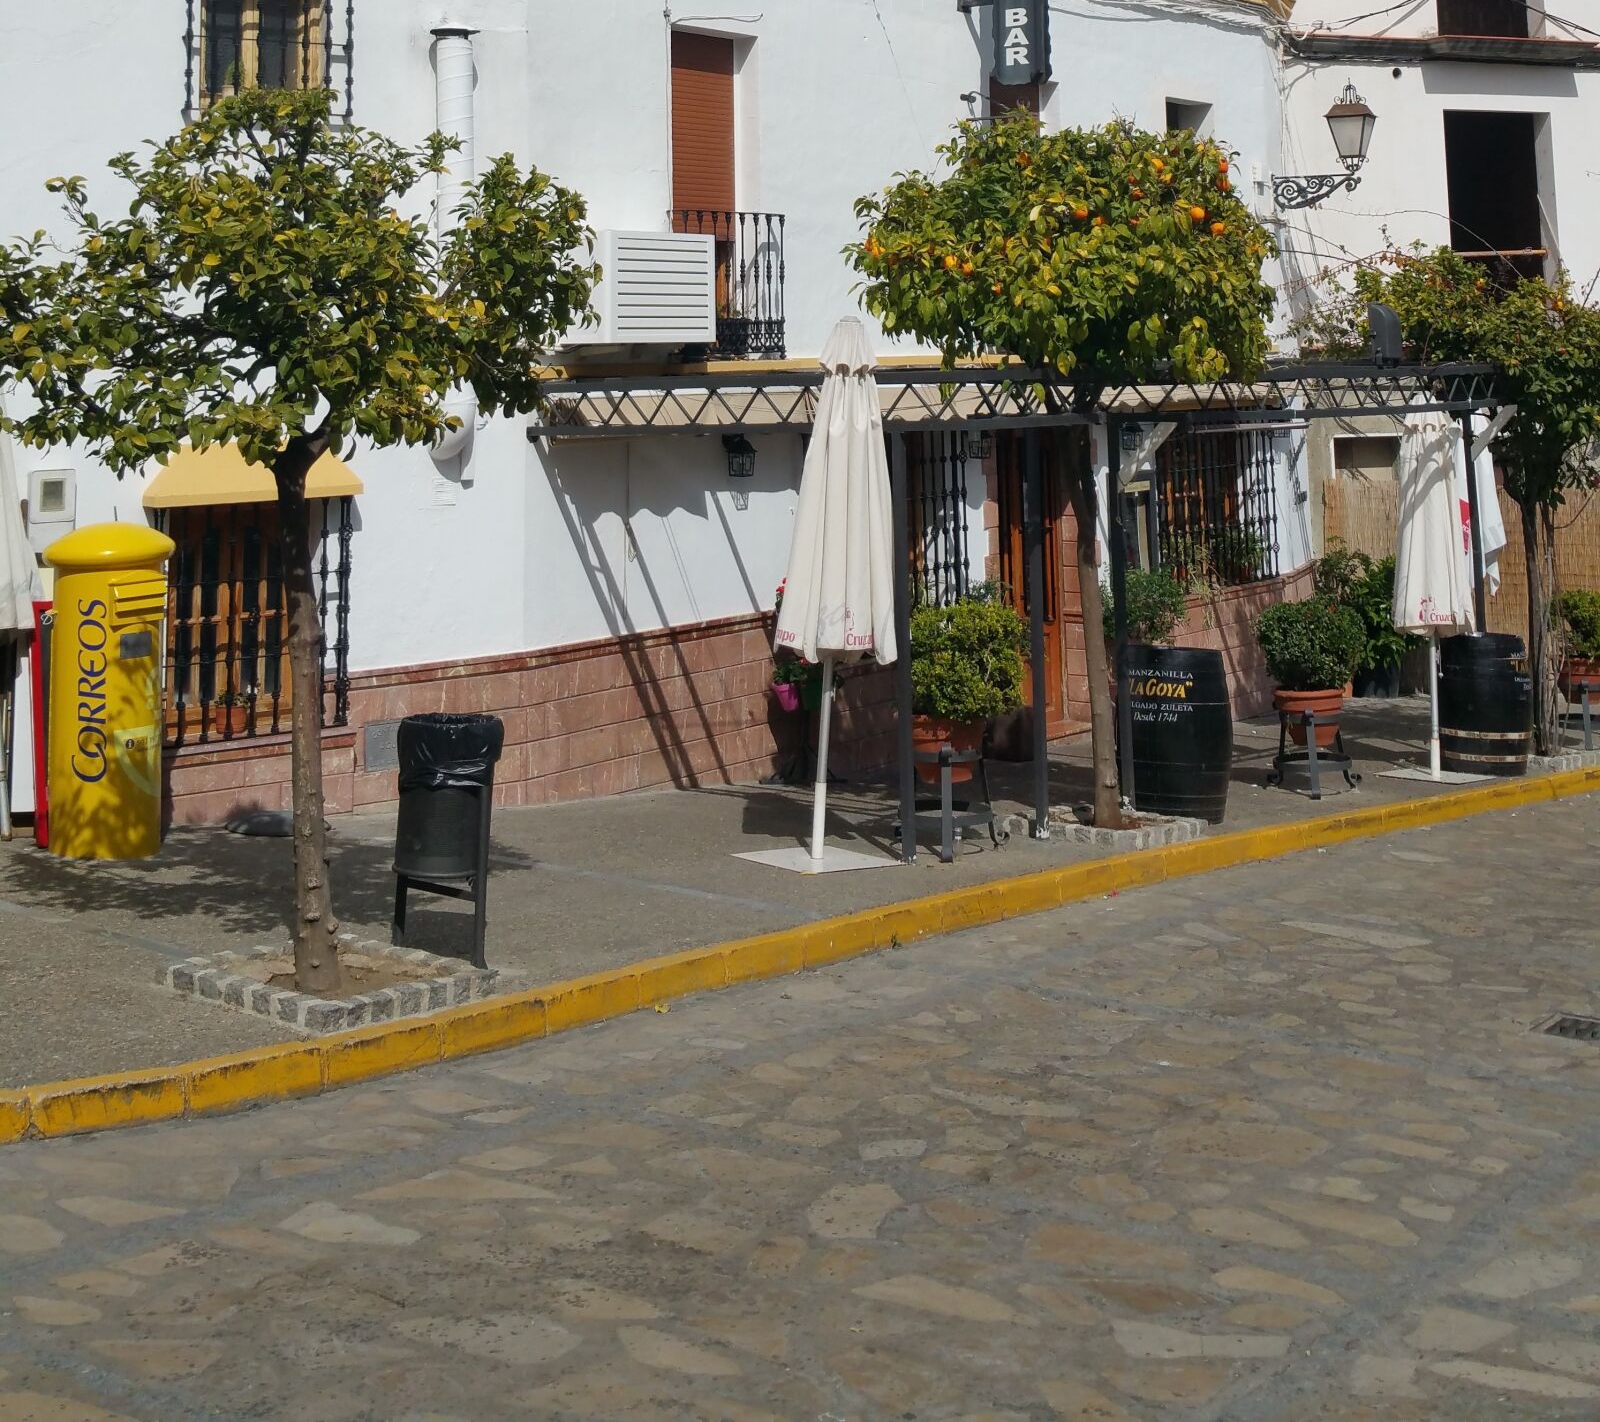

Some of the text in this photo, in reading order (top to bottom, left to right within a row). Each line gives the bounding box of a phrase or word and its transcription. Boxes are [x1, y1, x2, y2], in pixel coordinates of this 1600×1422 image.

[1004, 7, 1030, 67] BAR
[1129, 669, 1193, 680] MANZANILLA
[72, 599, 107, 783] CORREOS
[1131, 701, 1194, 712] LGADO ZULETA
[1133, 711, 1178, 722] Desde 1744
